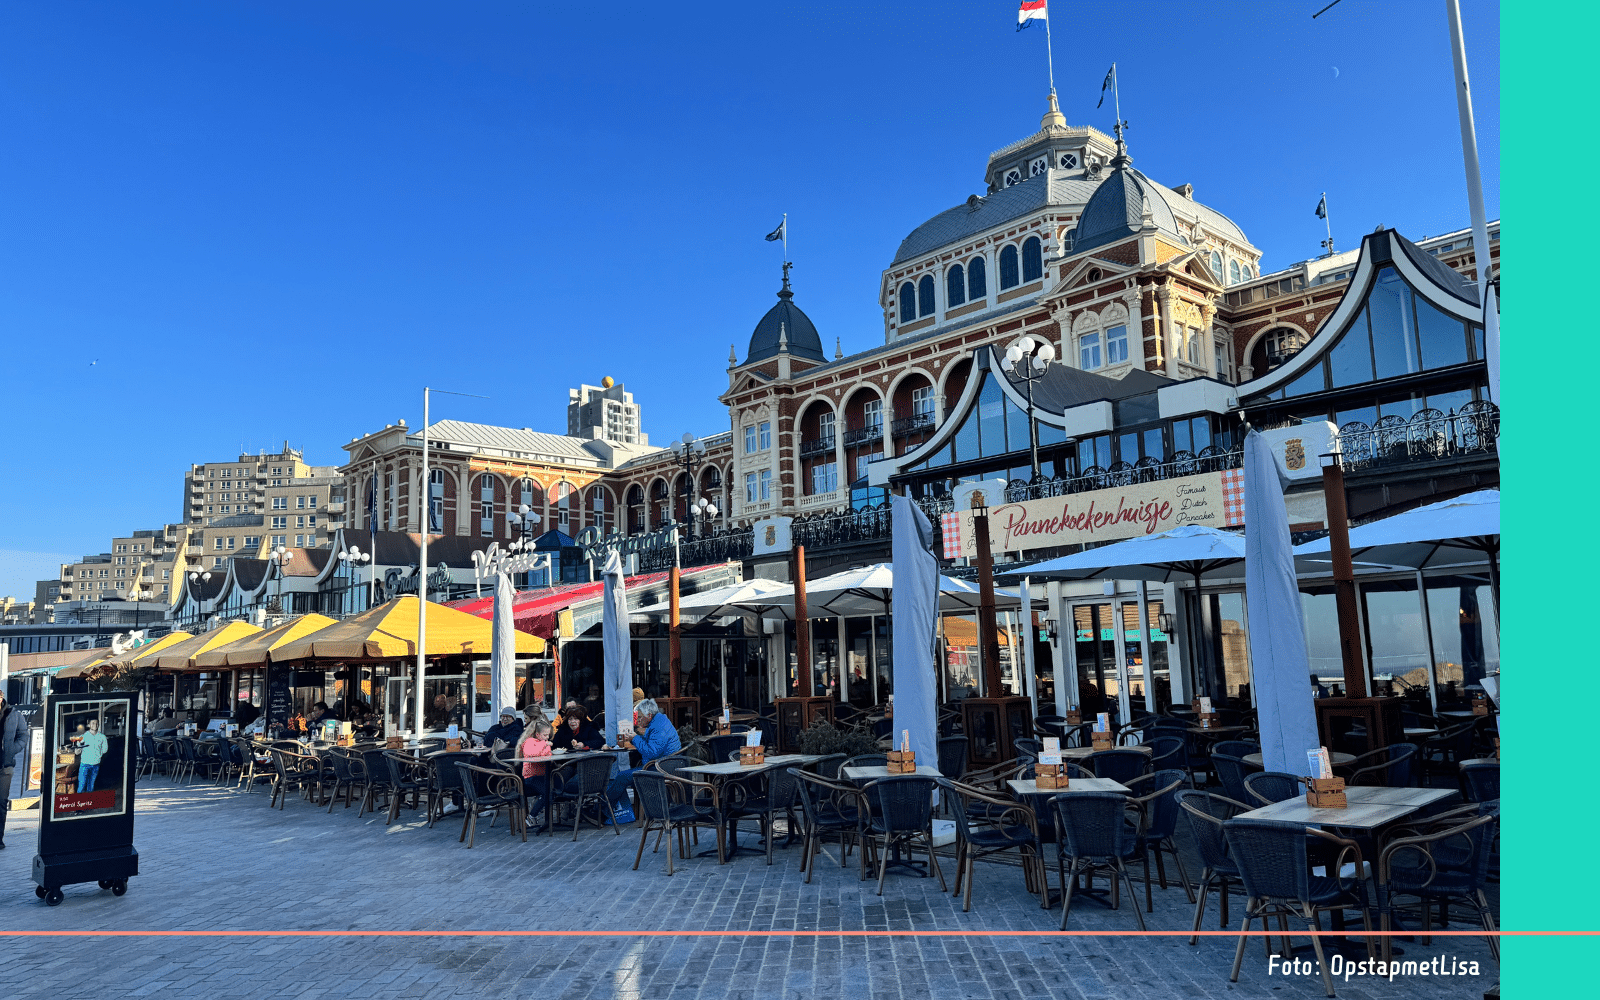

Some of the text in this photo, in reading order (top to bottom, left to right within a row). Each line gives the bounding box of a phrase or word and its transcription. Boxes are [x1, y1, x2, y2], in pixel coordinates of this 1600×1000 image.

[1176, 484, 1207, 498] Famous
[1180, 498, 1208, 510] Dutch
[993, 496, 1173, 550] Pannekoekenhuisje
[1175, 511, 1215, 524] Pancakes
[574, 518, 683, 566] Restaurant
[470, 541, 549, 578] Vitesse
